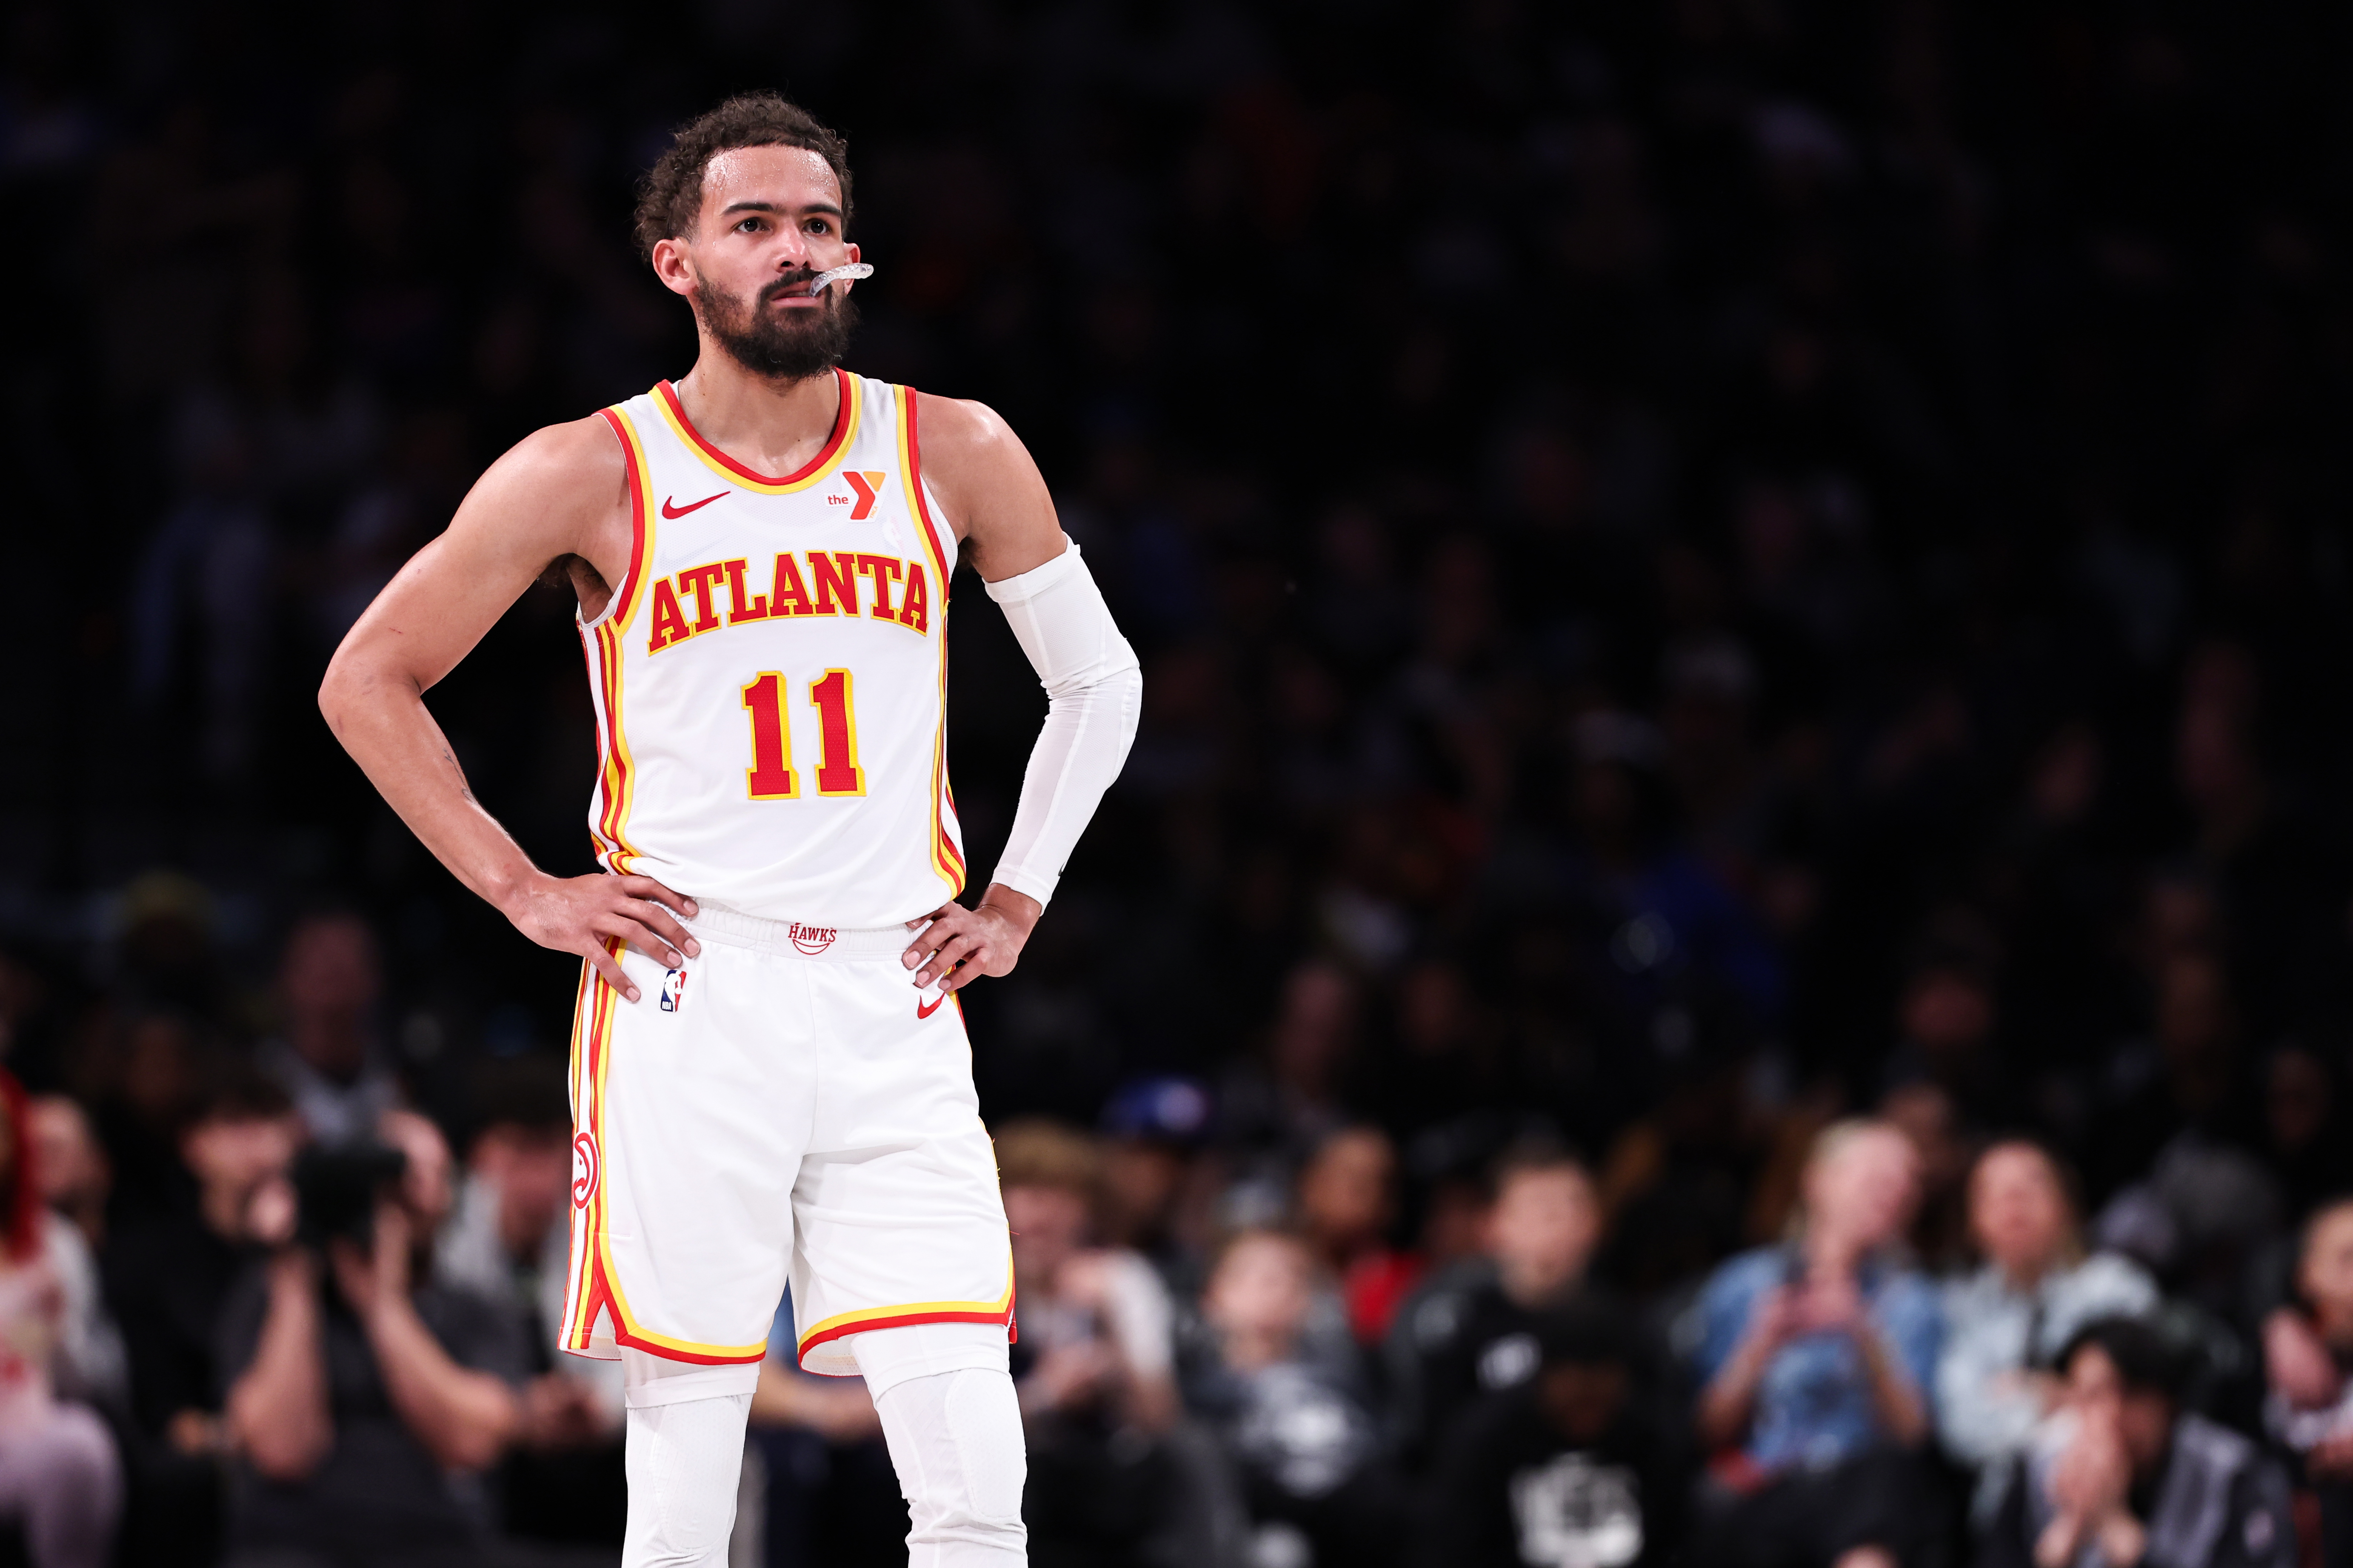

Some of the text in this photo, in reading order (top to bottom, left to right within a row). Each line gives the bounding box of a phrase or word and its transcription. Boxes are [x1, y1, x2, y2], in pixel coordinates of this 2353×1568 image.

[828, 495, 848, 505] the
[869, 506, 878, 518] YMCA
[647, 550, 928, 656] ATLANTA
[740, 667, 867, 800] 11
[788, 925, 837, 942] HAWKS
[662, 1001, 672, 1010] NBA
